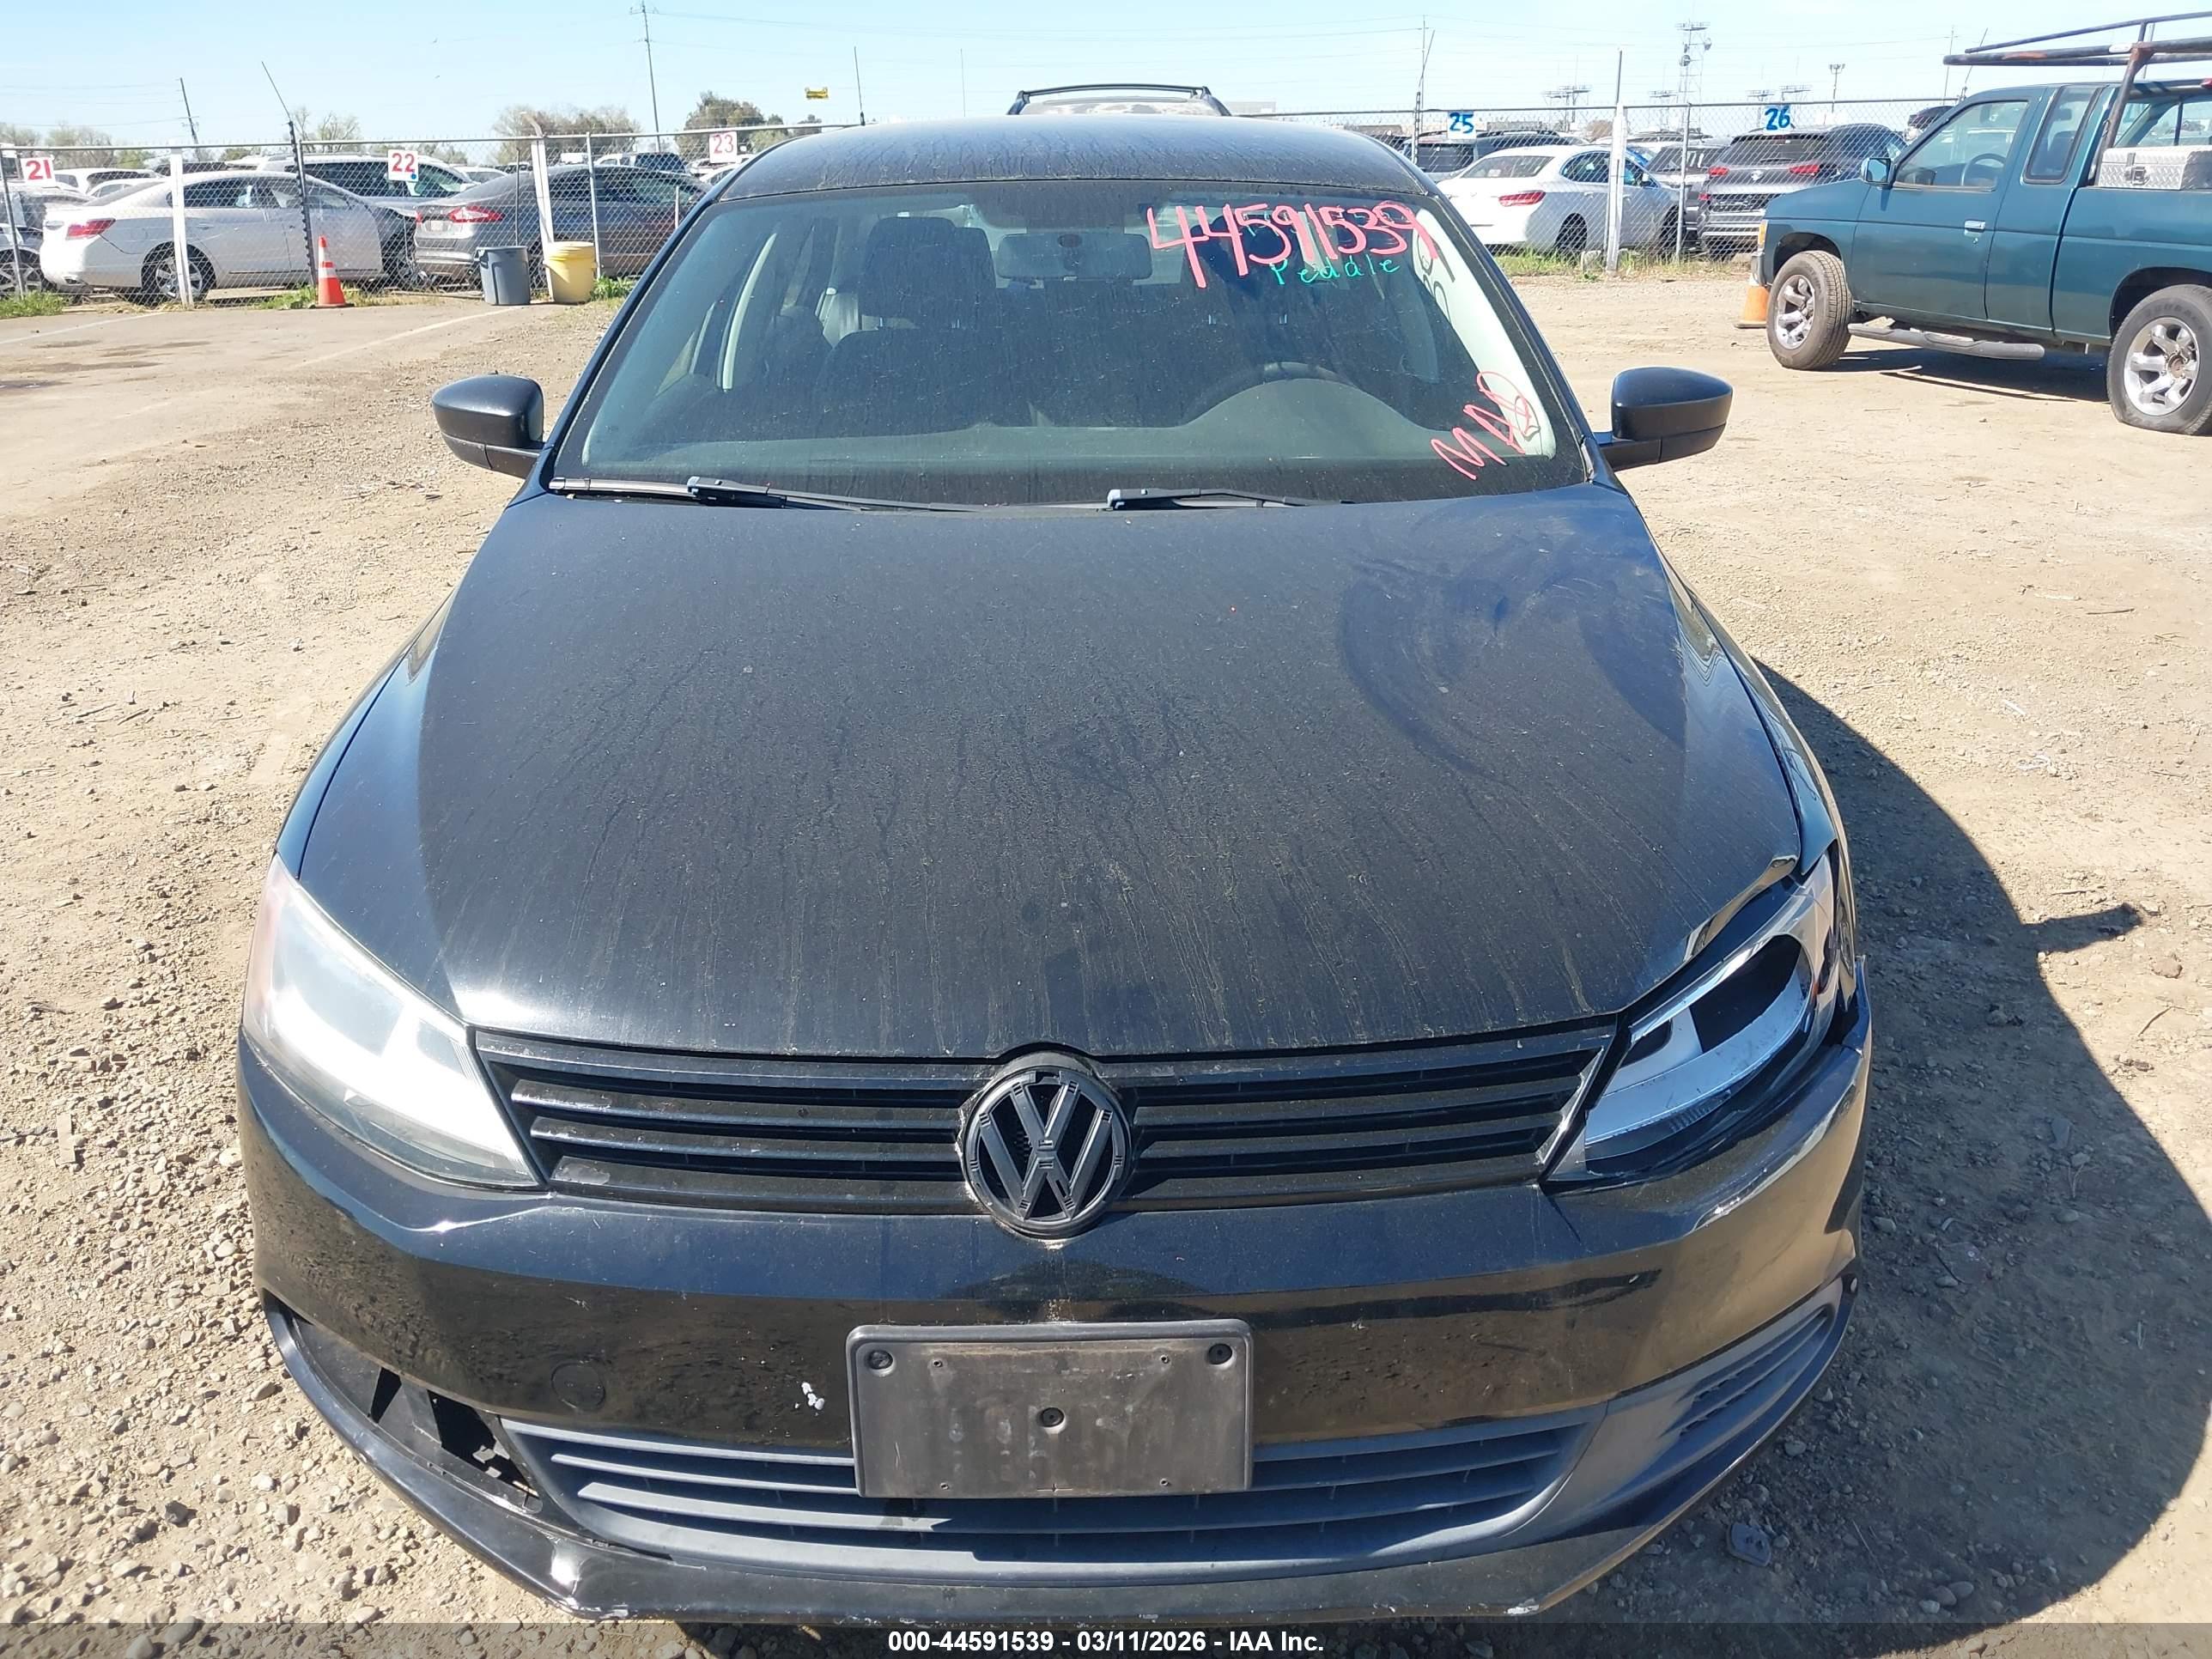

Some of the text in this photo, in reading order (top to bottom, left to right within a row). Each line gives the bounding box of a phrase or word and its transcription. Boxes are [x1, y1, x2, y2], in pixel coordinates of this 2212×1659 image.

[1449, 112, 1474, 133] 25
[1765, 104, 1790, 131] 26
[714, 134, 734, 154] 23
[26, 160, 52, 179] 21
[392, 153, 416, 172] 22
[1146, 201, 1438, 289] 44591539
[973, 1073, 1119, 1226] VW
